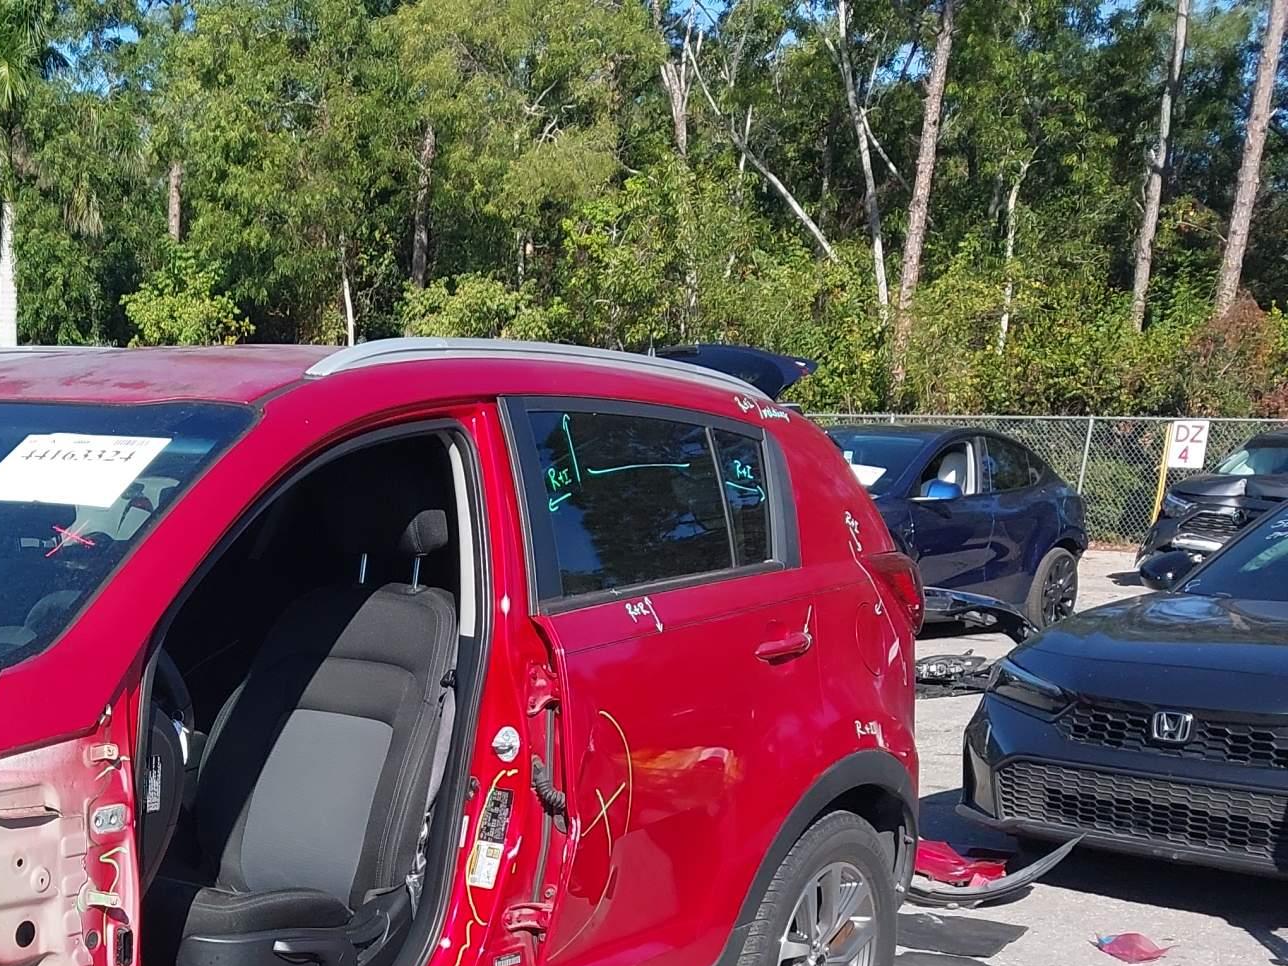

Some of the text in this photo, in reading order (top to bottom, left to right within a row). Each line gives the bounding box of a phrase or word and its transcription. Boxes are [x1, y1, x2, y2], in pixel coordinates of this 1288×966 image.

[1175, 424, 1205, 443] DZ
[21, 449, 137, 463] 44163324
[1178, 446, 1190, 463] 4
[548, 467, 572, 491] R+I
[734, 460, 754, 480] R+I
[844, 510, 860, 534] R+I
[625, 602, 650, 623] R+R
